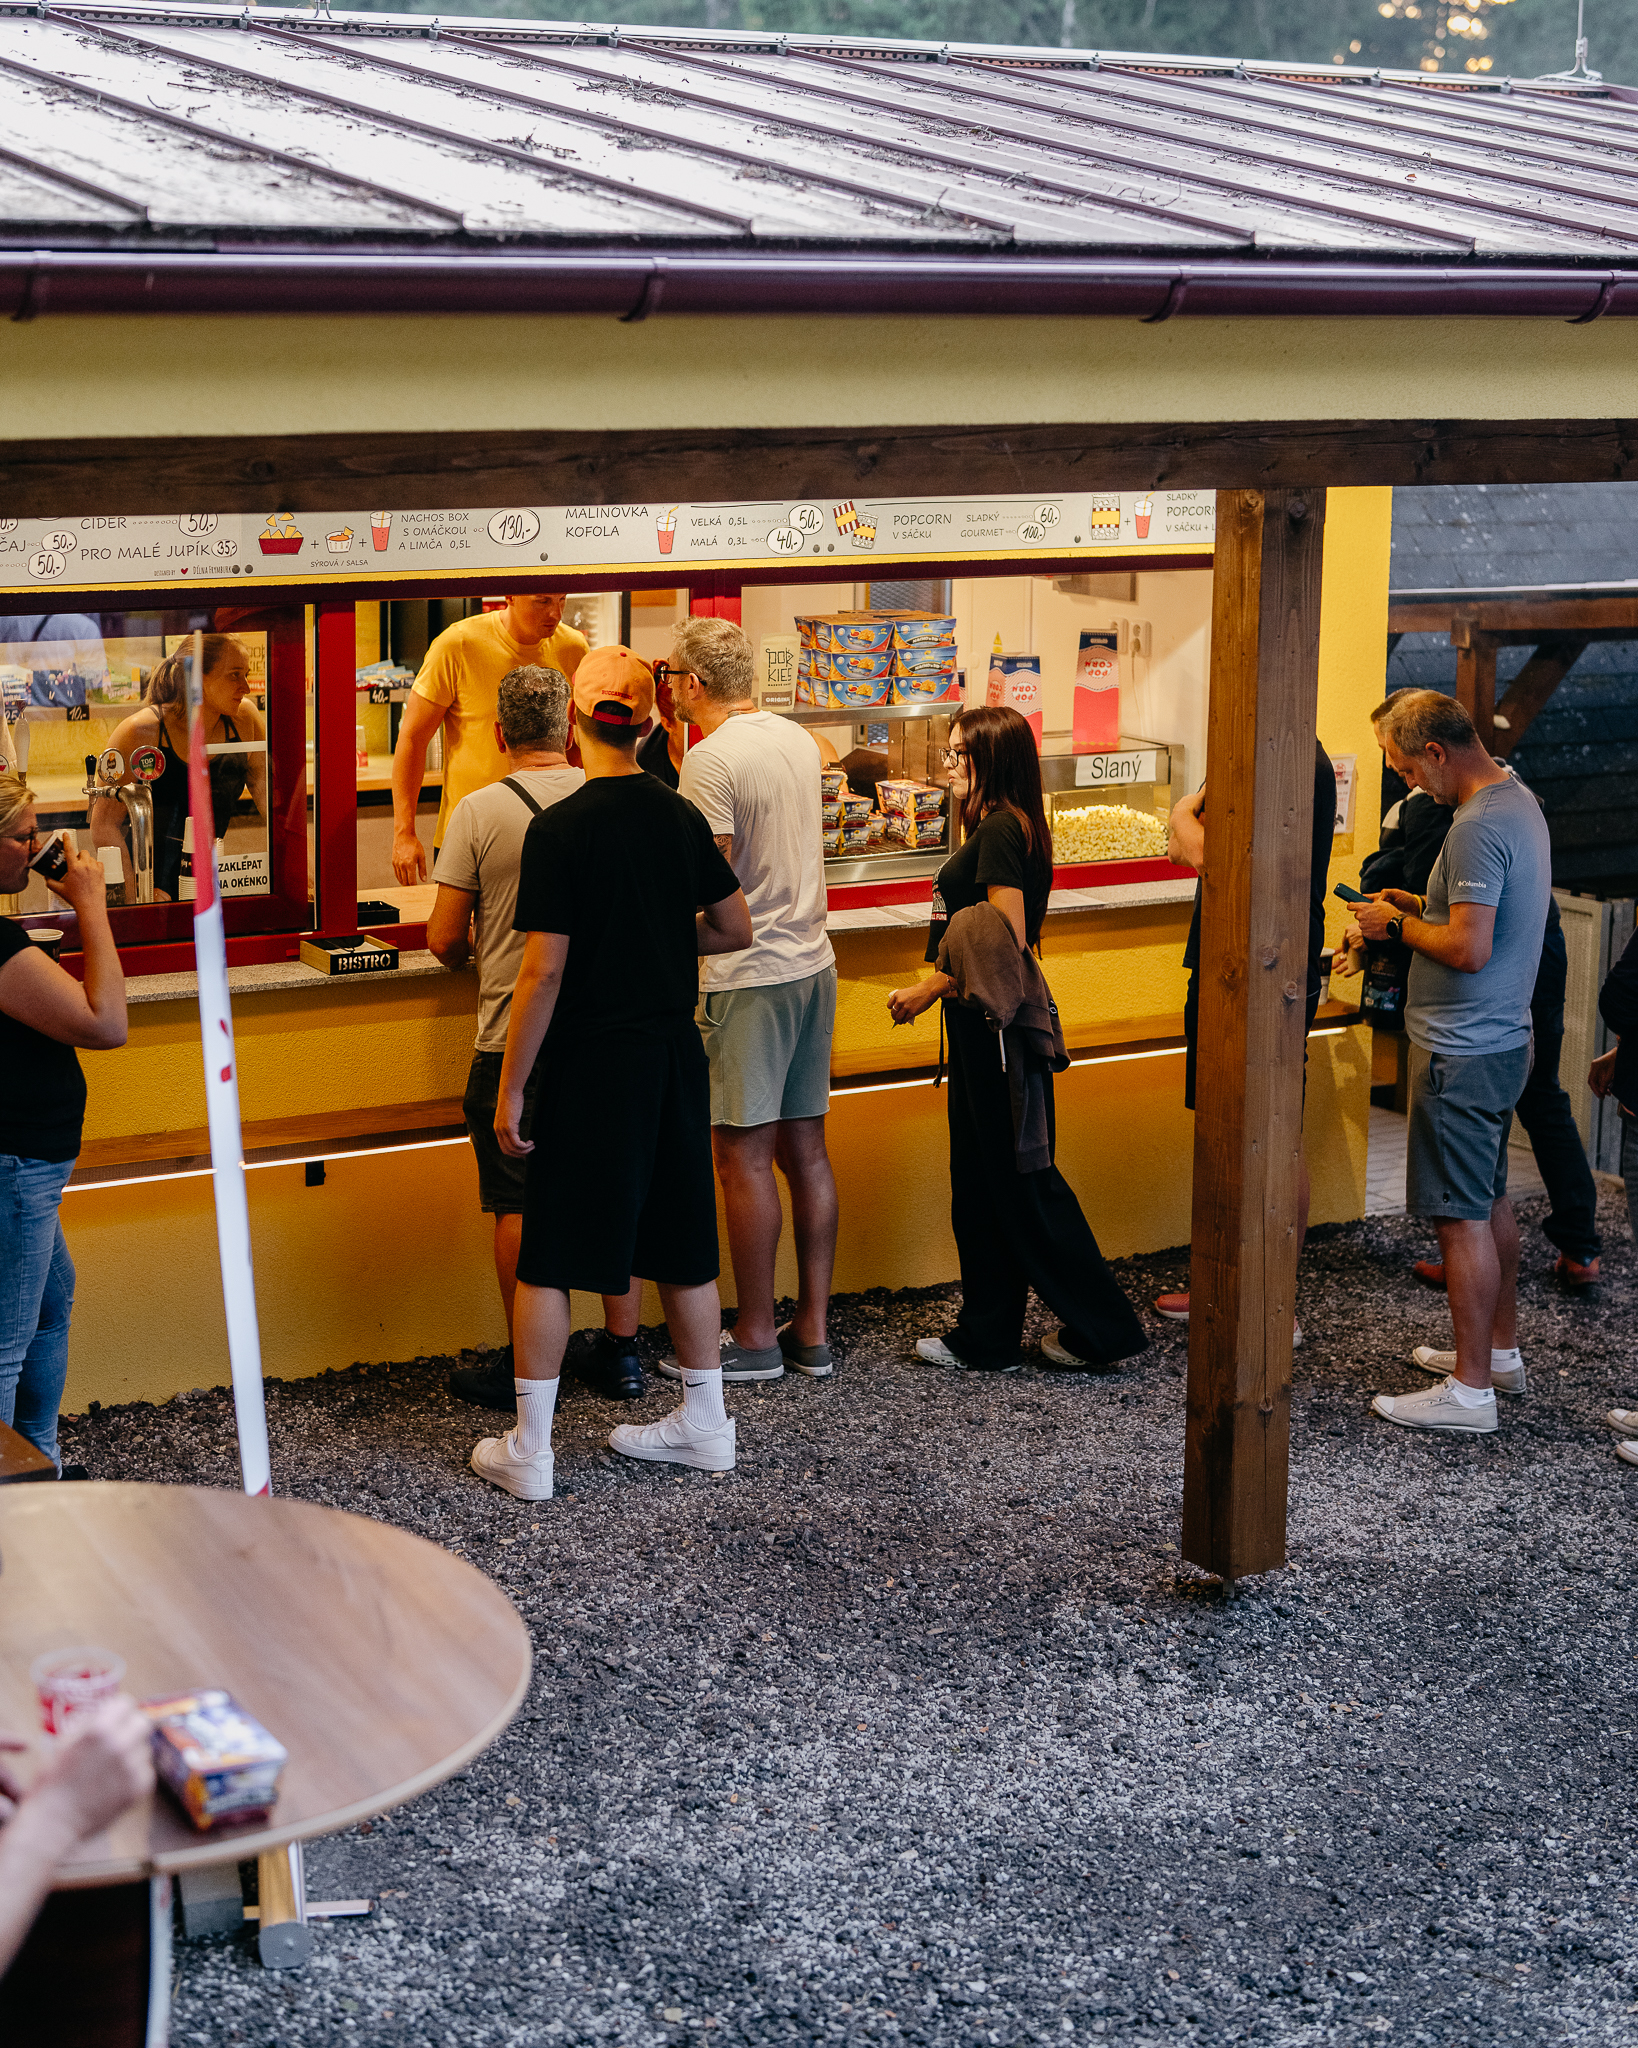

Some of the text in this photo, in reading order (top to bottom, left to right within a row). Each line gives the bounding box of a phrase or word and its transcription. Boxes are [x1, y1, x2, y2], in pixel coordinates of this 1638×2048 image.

[1166, 491, 1198, 501] SLADKÝ
[401, 513, 469, 523] NACHOS BOX
[565, 506, 649, 519] MALINOVKA
[691, 509, 820, 529] VELKÁ 0,5L 50,-
[893, 507, 1058, 526] POPCORN SLADKÝ 60,-
[81, 516, 127, 530] CIDER
[403, 515, 531, 540] S OMÁČKOU 130,-
[1165, 524, 1172, 532] V
[1174, 522, 1202, 532] SÁČKU
[565, 525, 620, 538] KOFOLA
[893, 524, 1043, 540] V SÁČKU GOURMET 100,-
[53, 534, 73, 550] 50,-
[399, 539, 471, 550] A LIMČA 0,5L
[690, 530, 798, 550] MALÁ 0,3L 40,-
[81, 548, 112, 560] PRO
[117, 542, 161, 558] MALÉ
[166, 540, 211, 558] JUPÍK
[37, 554, 60, 575] 50,-
[310, 559, 339, 568] SÝROVÁ
[346, 559, 369, 567] SALSA
[1091, 754, 1142, 782] Slaný
[218, 859, 263, 873] ZAKLEPAT
[231, 875, 268, 888] OKÉNKO
[338, 953, 391, 971] BISTRO
